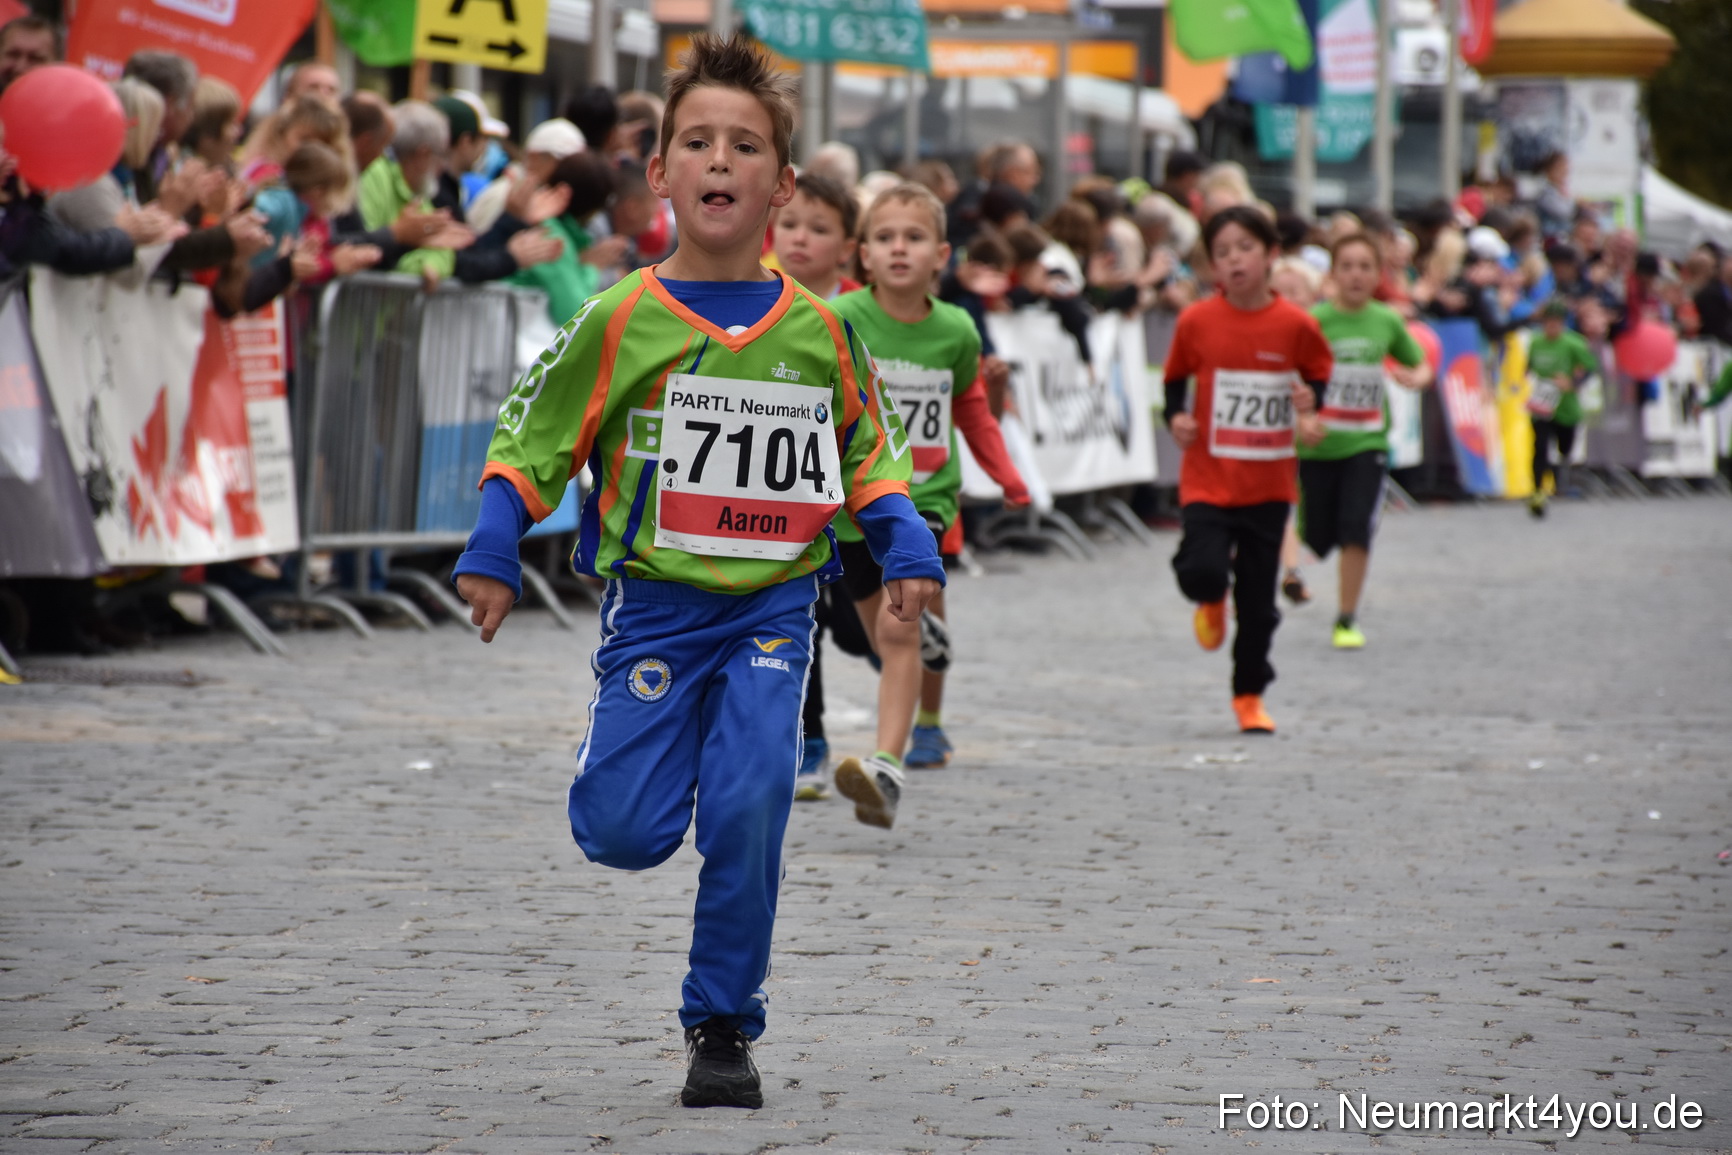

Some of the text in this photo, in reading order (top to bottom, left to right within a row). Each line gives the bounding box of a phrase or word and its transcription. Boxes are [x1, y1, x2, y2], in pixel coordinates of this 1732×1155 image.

[670, 391, 811, 420] PARTL Neumarkt
[685, 420, 826, 493] 7104
[666, 478, 673, 488] 4
[828, 490, 835, 500] K
[716, 506, 787, 534] Aaron
[751, 656, 790, 672] LEGEA
